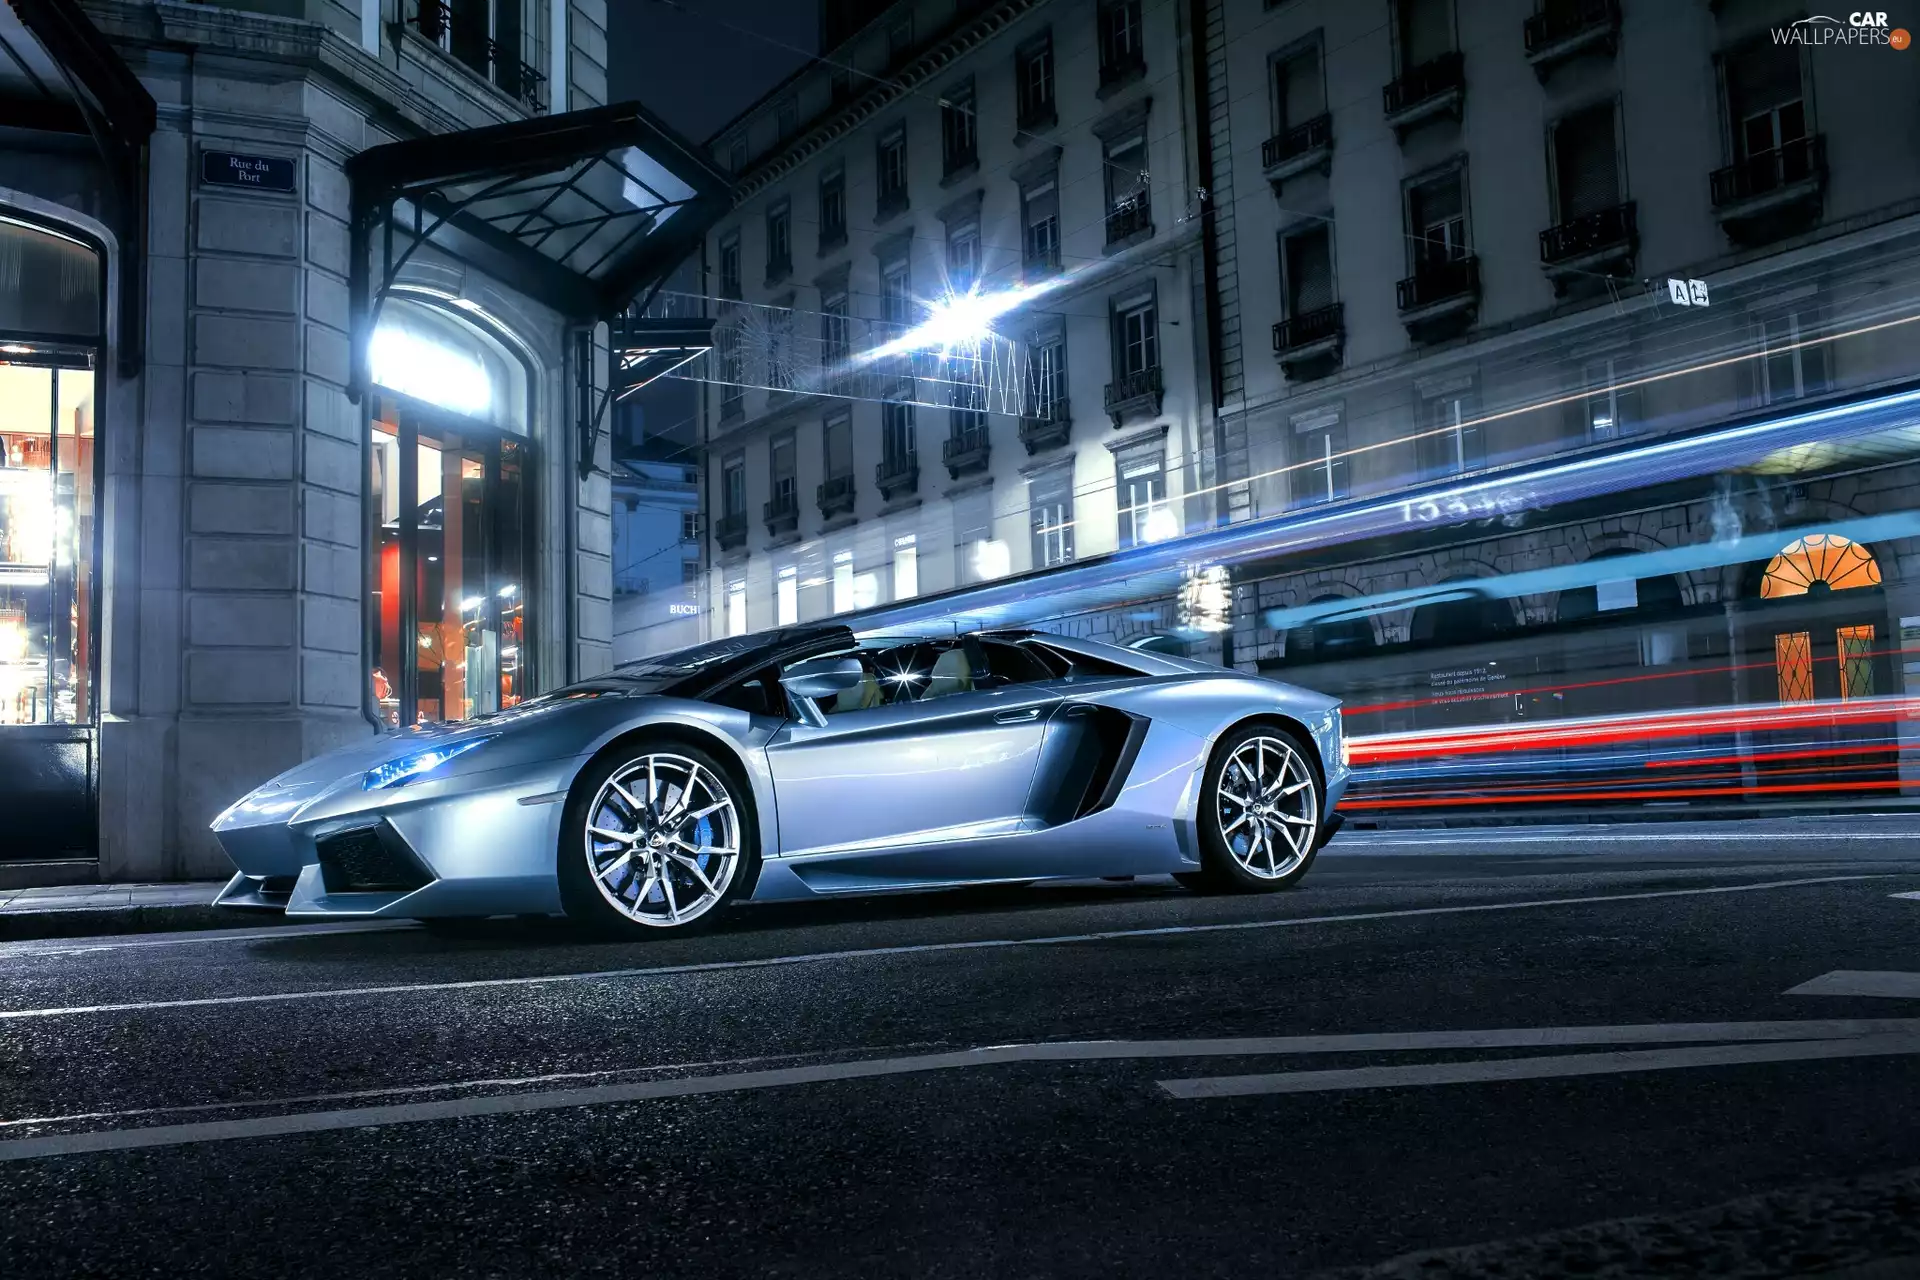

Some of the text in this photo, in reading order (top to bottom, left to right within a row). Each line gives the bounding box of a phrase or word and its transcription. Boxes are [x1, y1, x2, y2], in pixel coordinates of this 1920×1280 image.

[230, 157, 269, 172] Rue du
[238, 170, 260, 182] Port
[1676, 285, 1686, 300] A
